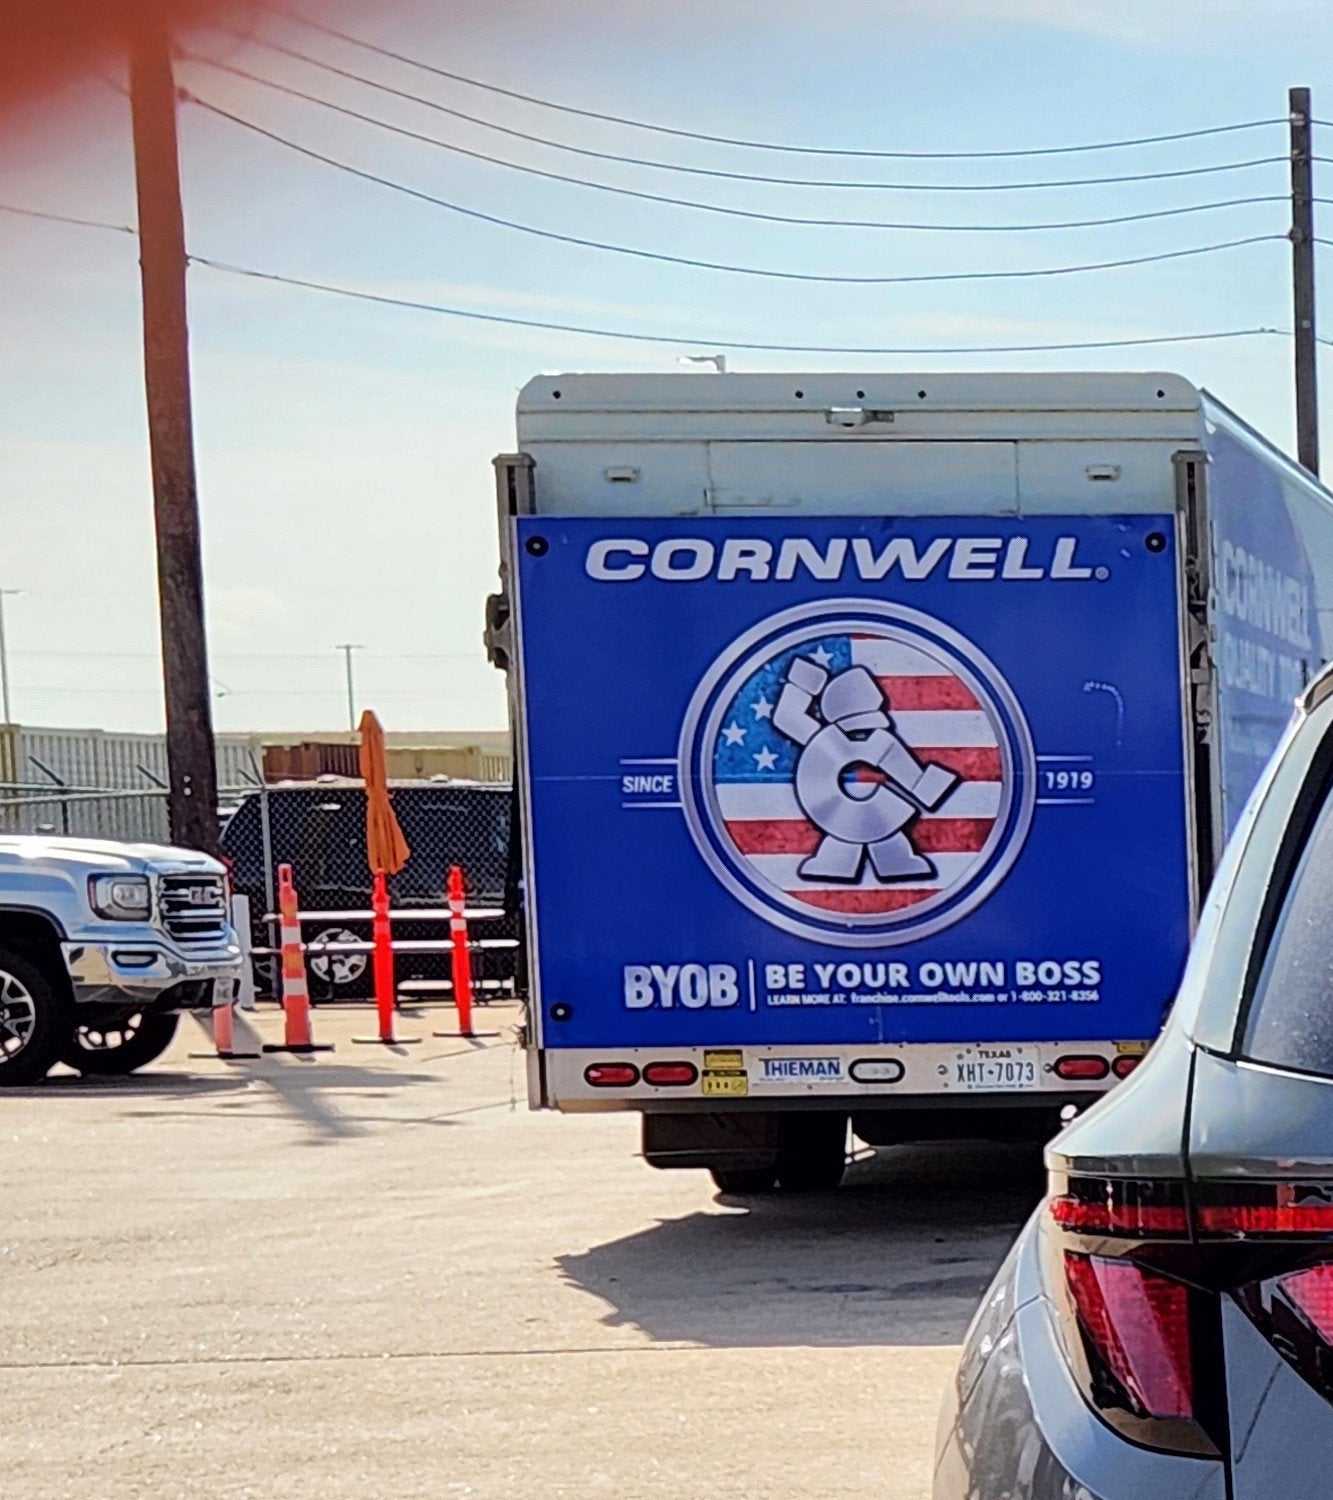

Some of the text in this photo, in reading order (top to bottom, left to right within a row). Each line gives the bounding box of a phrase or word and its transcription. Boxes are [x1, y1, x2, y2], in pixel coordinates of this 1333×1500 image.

[584, 537, 1094, 581] CORNWELL
[622, 771, 1094, 794] SINCE 1919
[764, 960, 1101, 990] BE YOUR OWN BOSS
[758, 1056, 842, 1078] THIEMAN
